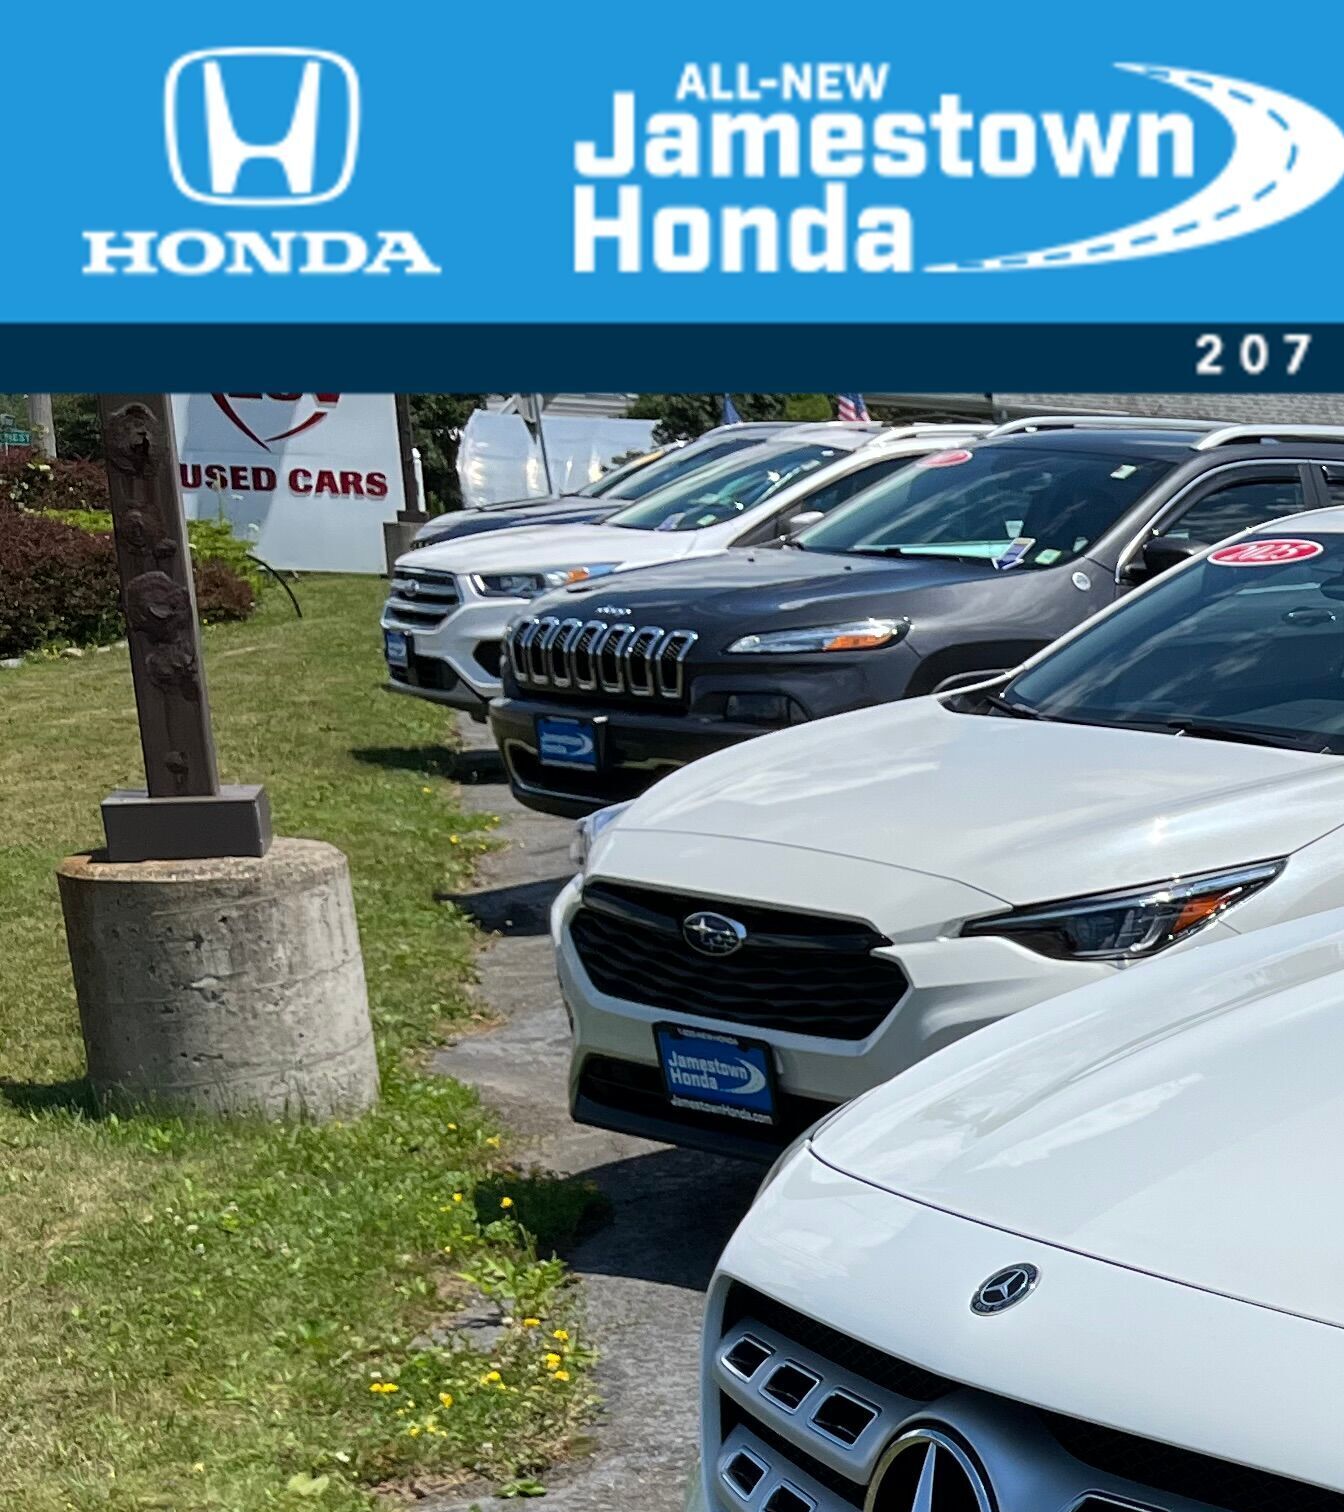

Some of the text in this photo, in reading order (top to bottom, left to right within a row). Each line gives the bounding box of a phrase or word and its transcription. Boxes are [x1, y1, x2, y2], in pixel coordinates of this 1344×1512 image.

[180, 462, 388, 498] USED CARS
[1216, 543, 1313, 562] 2025
[668, 1050, 748, 1080] Jamestown
[670, 1067, 718, 1090] Honda
